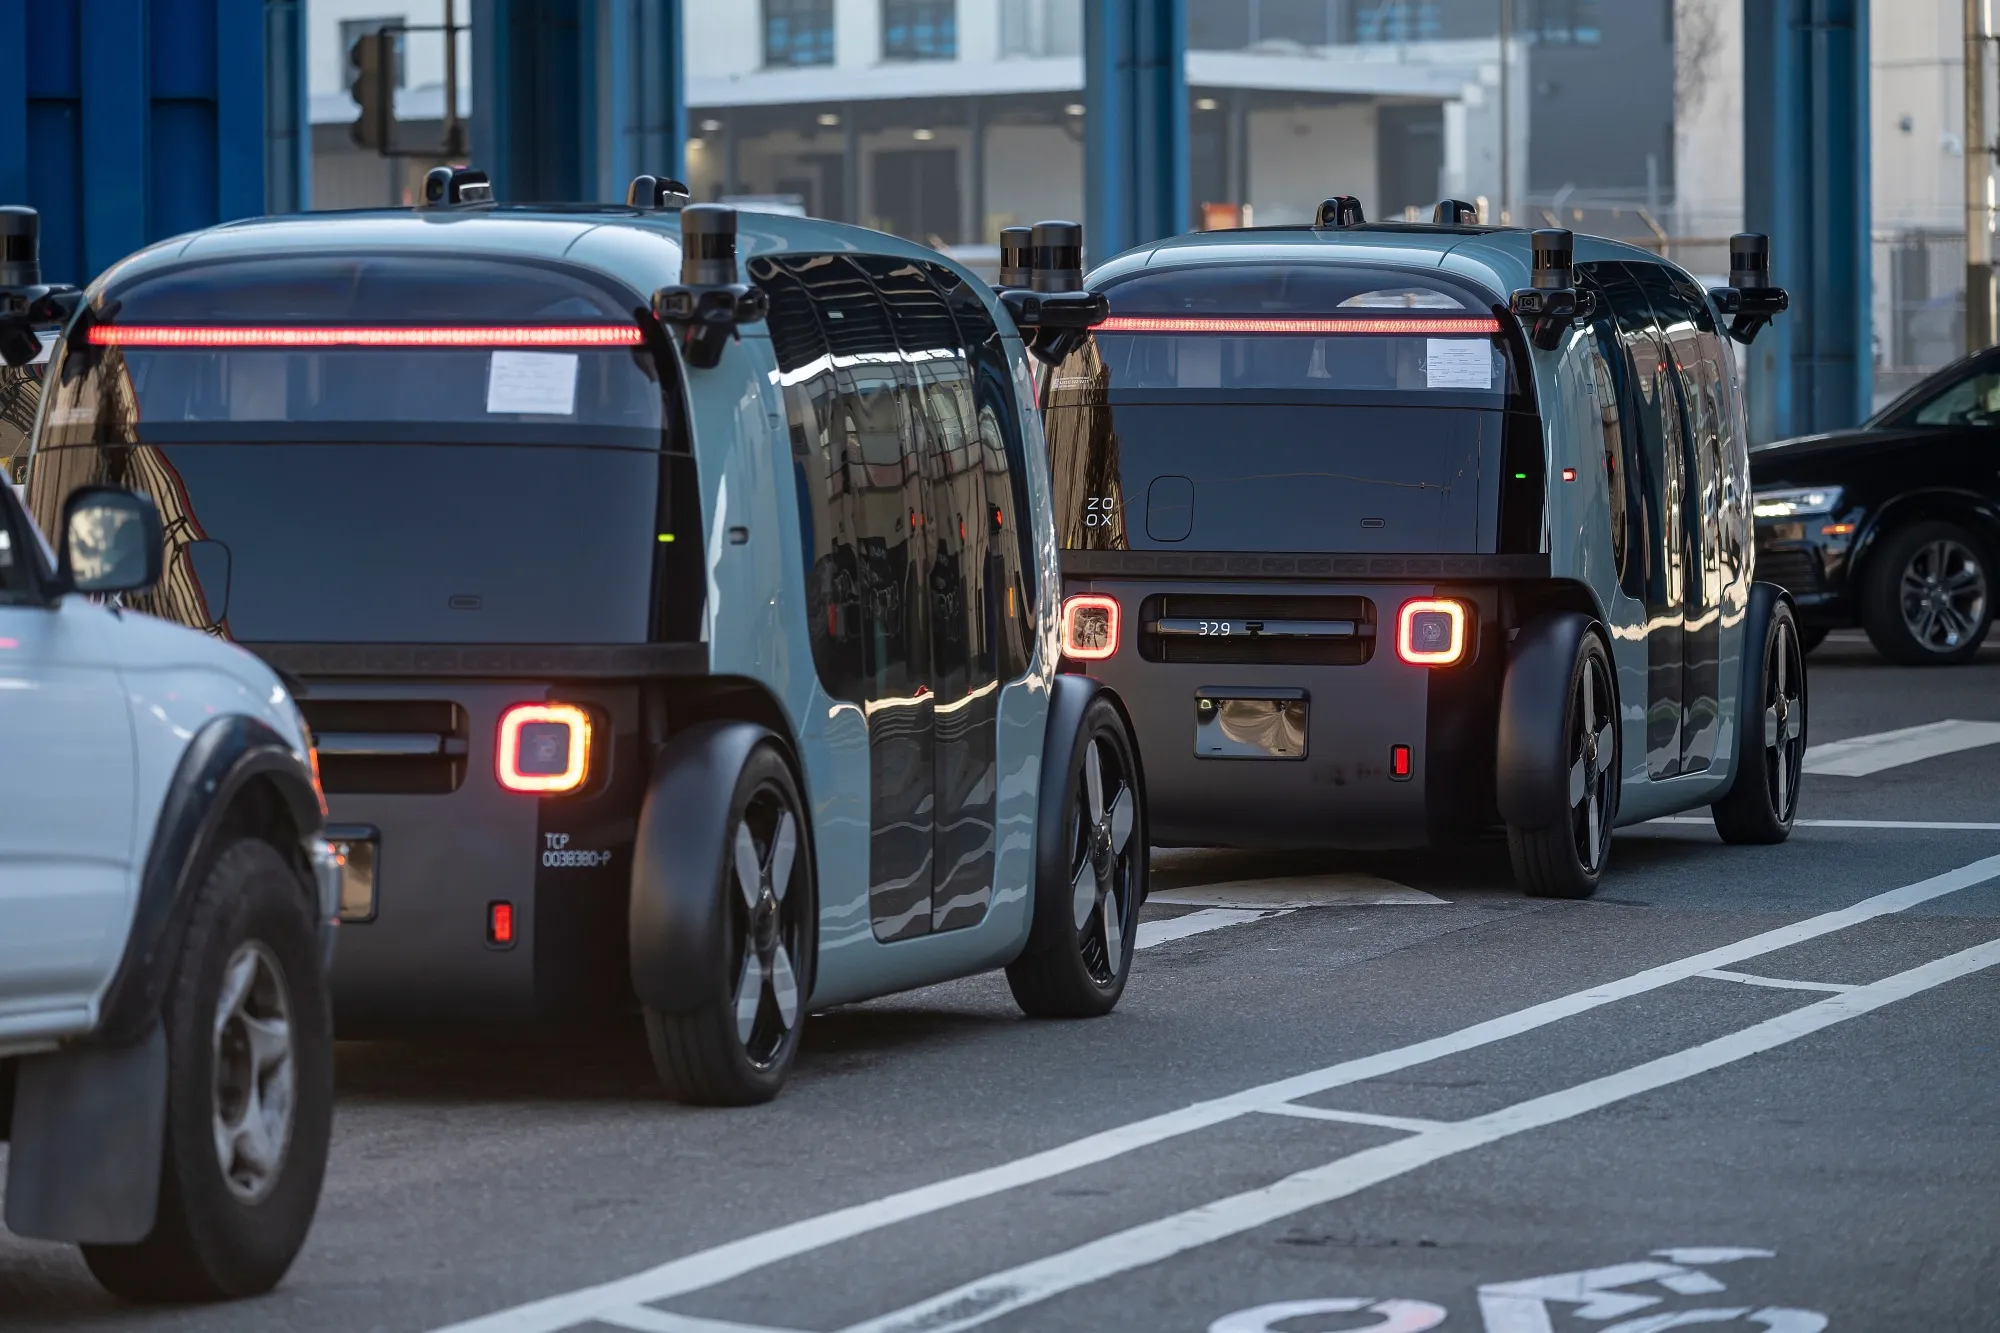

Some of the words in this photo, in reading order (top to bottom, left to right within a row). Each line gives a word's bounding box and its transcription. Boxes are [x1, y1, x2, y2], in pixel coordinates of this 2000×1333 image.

[1087, 497, 1114, 510] ZO
[1086, 513, 1113, 526] OX
[1198, 622, 1231, 636] 329
[544, 832, 570, 849] TCP
